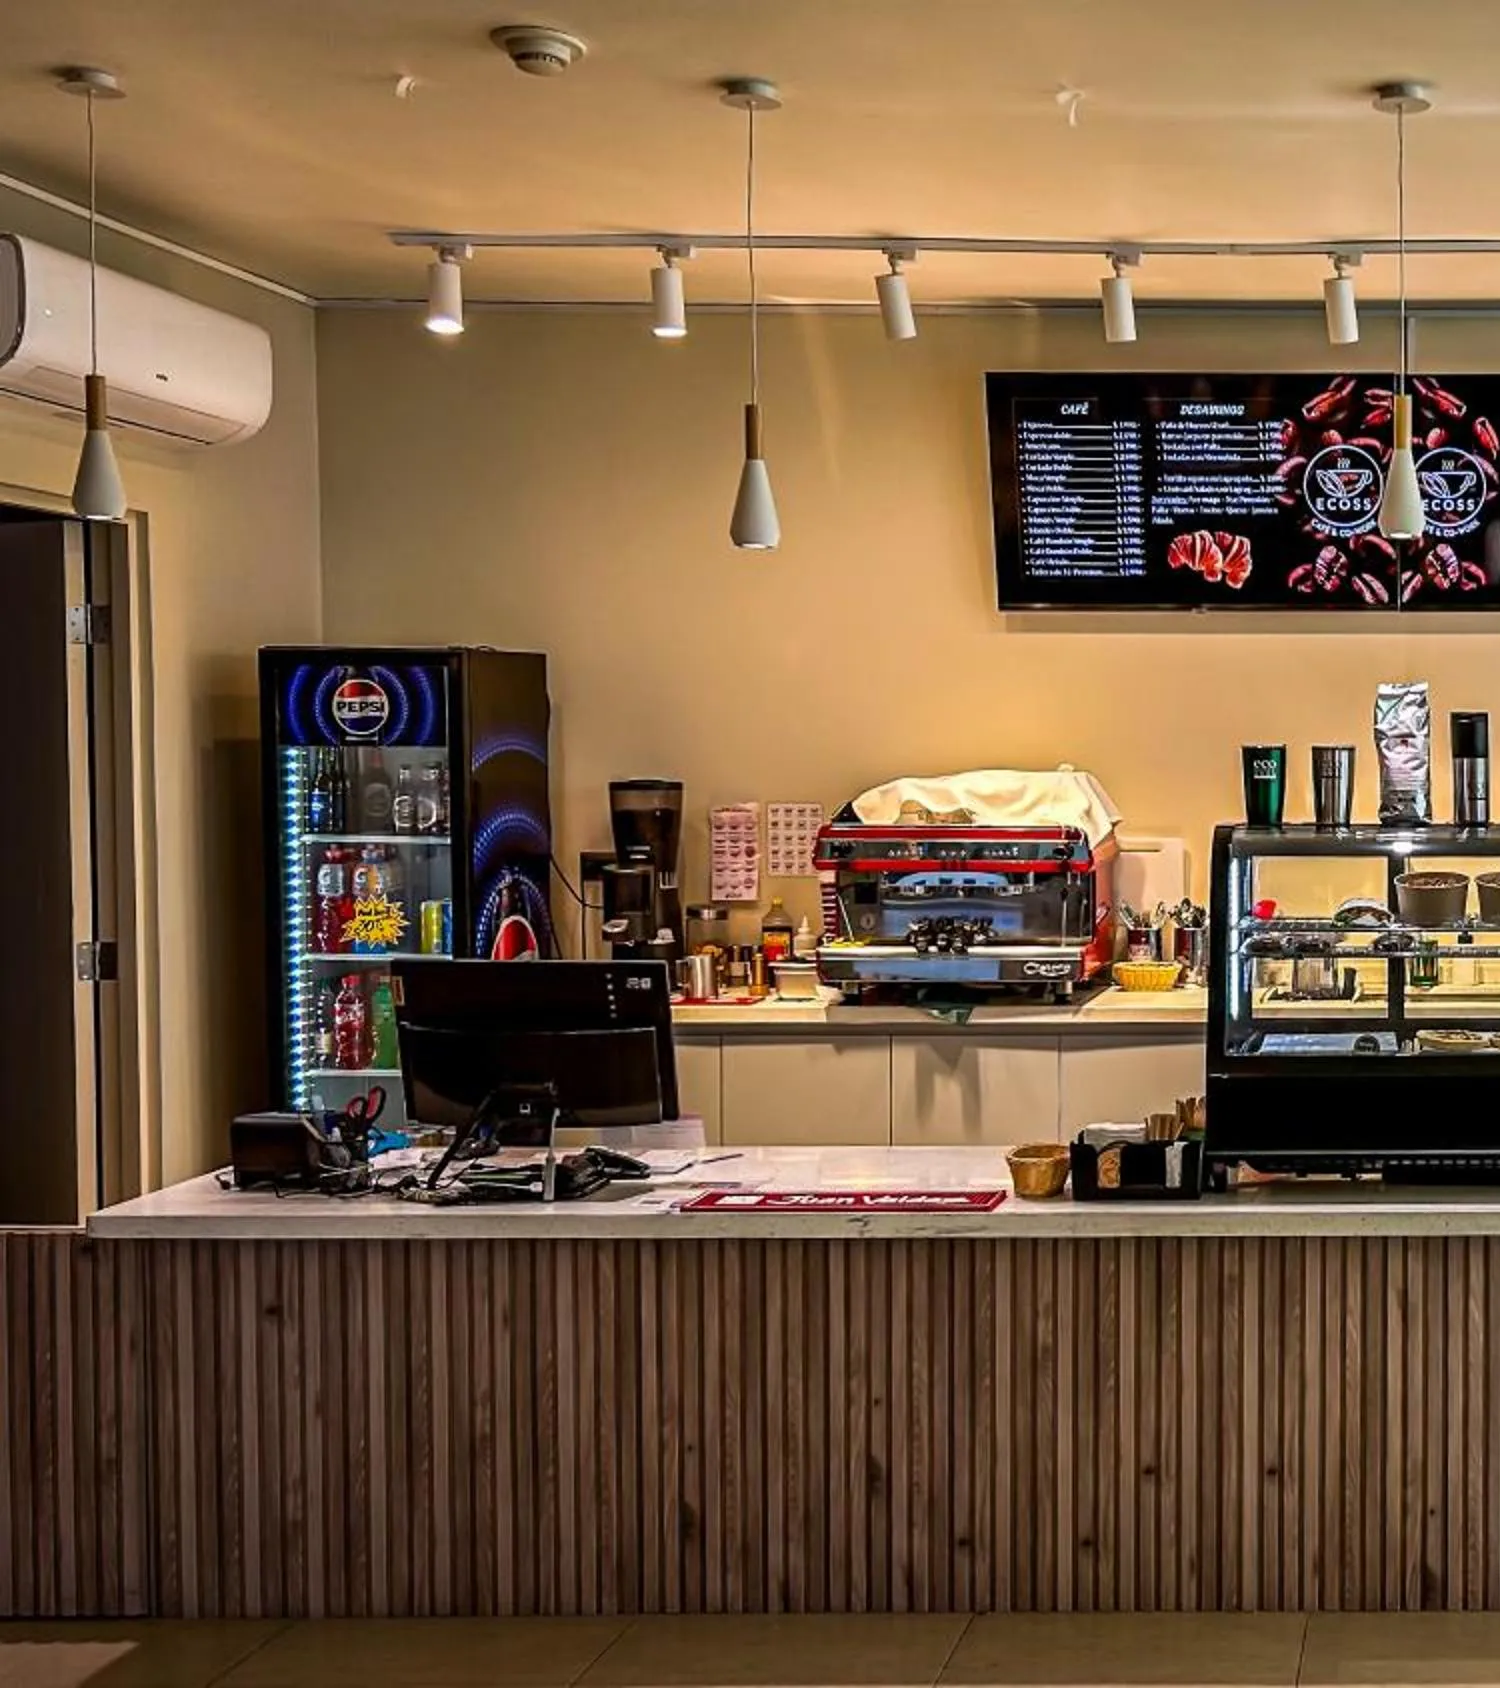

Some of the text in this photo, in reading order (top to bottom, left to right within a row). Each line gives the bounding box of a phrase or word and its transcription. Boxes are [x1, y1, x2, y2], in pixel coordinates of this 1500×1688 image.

[1061, 401, 1089, 415] CAFÉ
[1315, 497, 1372, 511] ECOSS
[1422, 499, 1476, 511] ECOSS
[337, 701, 385, 712] PEPSI
